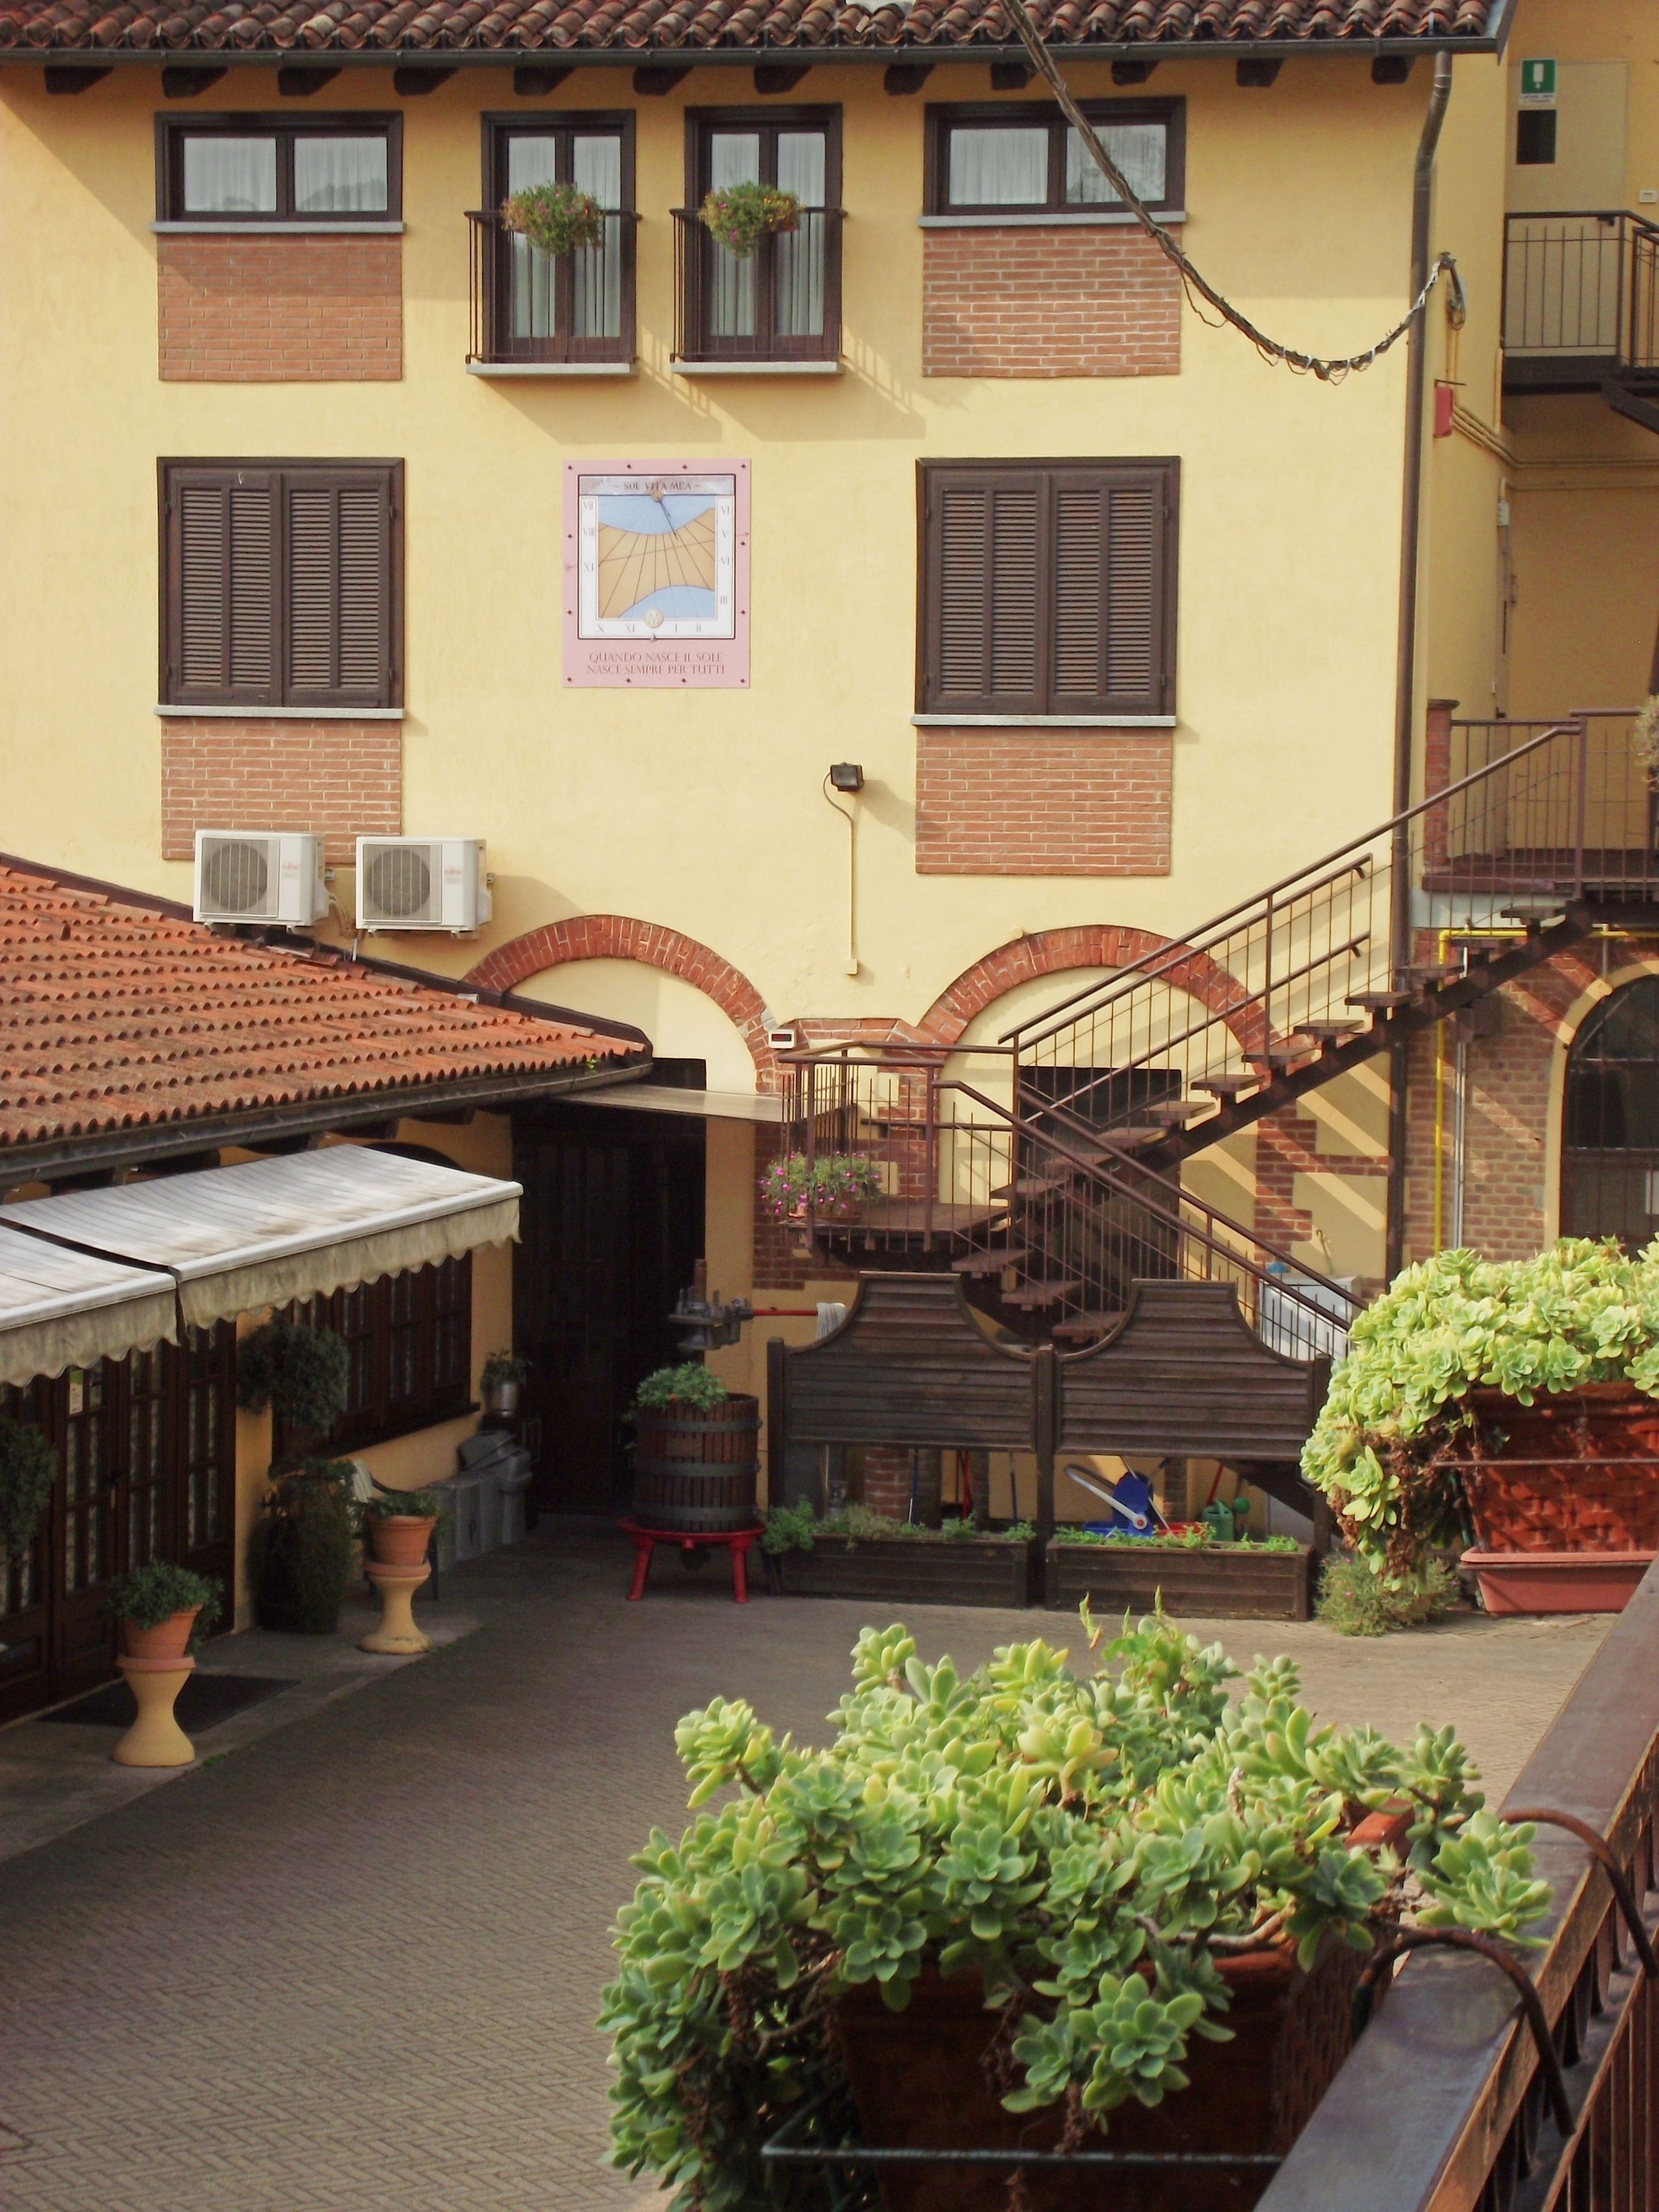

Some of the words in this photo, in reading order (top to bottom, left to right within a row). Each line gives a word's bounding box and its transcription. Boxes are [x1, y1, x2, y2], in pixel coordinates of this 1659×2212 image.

[623, 482, 641, 491] SOL
[645, 482, 668, 491] VITA
[669, 482, 692, 491] MEA
[721, 529, 729, 539] V
[720, 596, 728, 605] III
[596, 623, 605, 634] X
[589, 652, 642, 664] QUANDO
[645, 652, 681, 662] NASCE
[684, 652, 693, 662] IL
[696, 652, 723, 662] SOLE
[586, 664, 622, 675] NASCE
[624, 664, 664, 675] SEMPRE
[668, 664, 686, 675] PER
[691, 664, 725, 675] TUTTI
